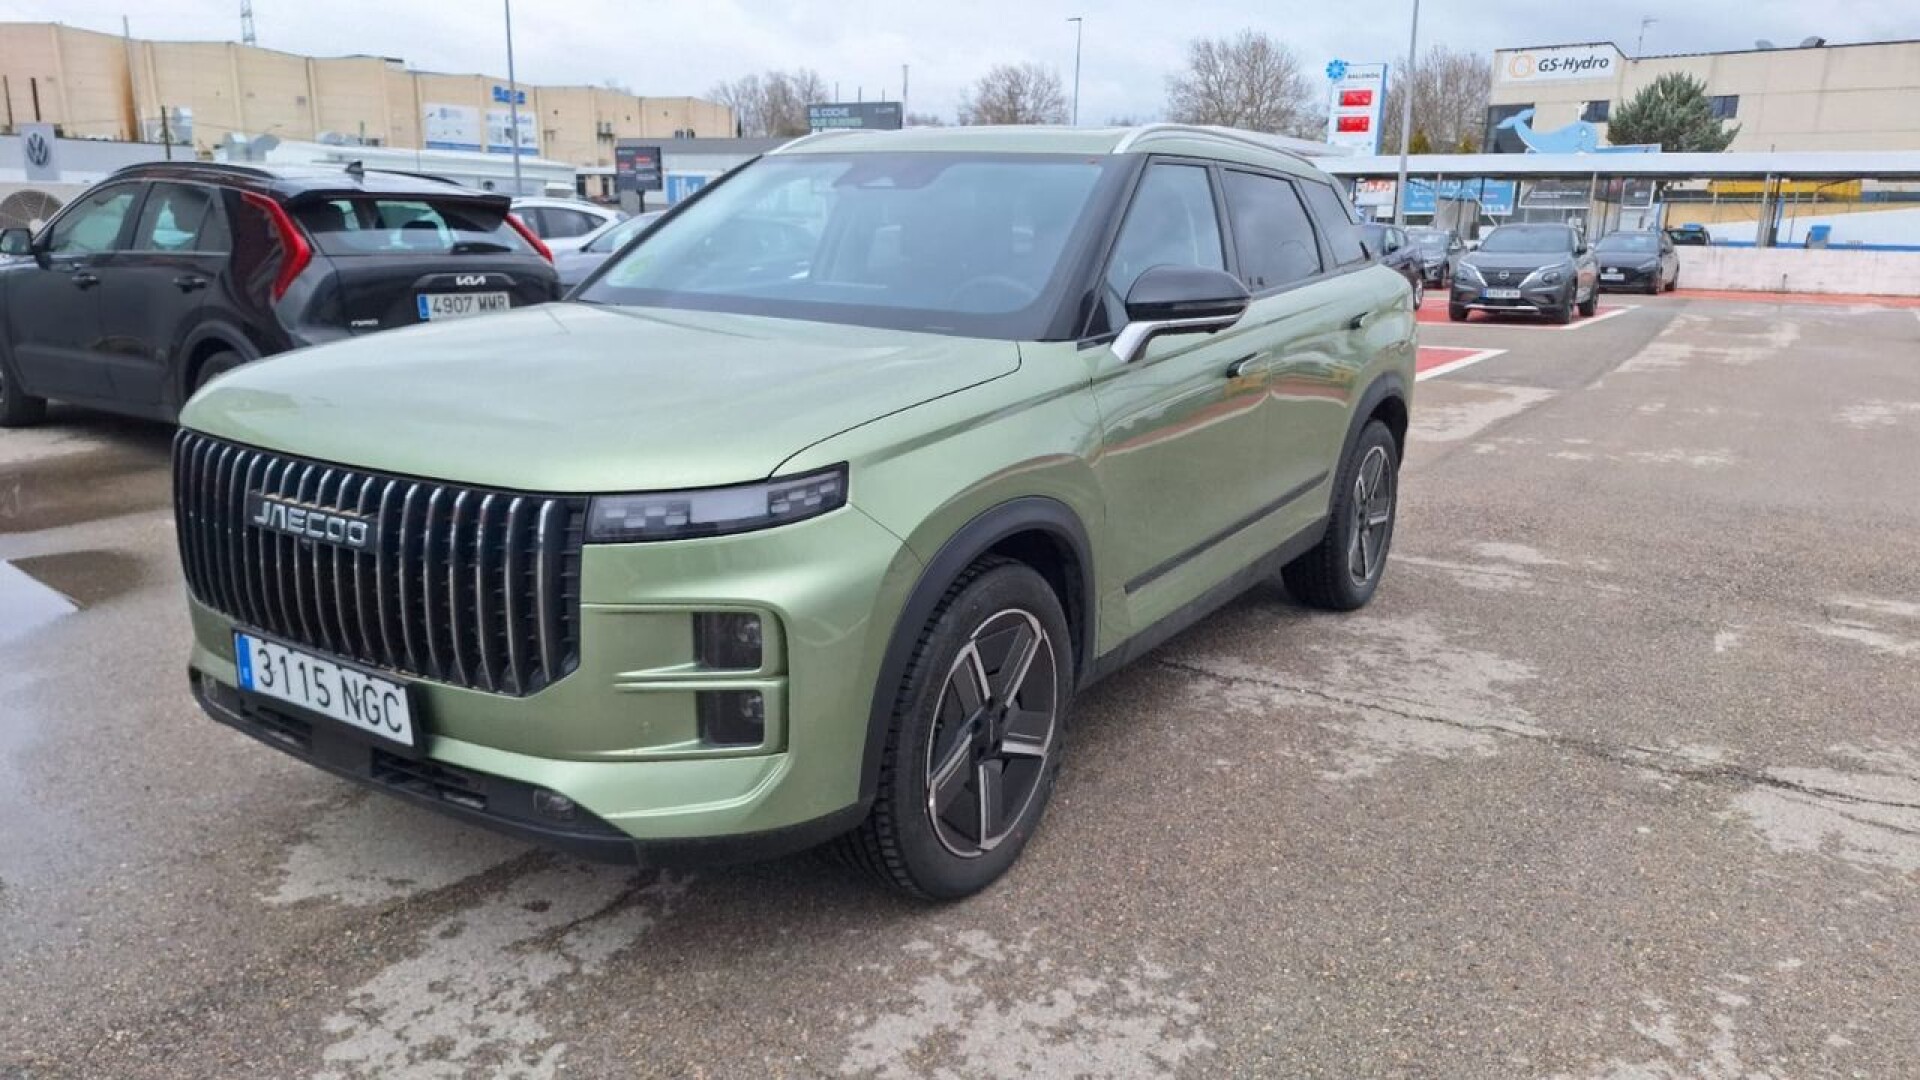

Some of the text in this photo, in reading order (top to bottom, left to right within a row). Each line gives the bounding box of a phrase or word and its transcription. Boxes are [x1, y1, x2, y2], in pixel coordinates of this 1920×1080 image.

[1538, 55, 1609, 73] GS-Hydro
[432, 293, 472, 314] 4907
[253, 500, 369, 547] JAECOO
[257, 648, 403, 733] 3115 NGC
